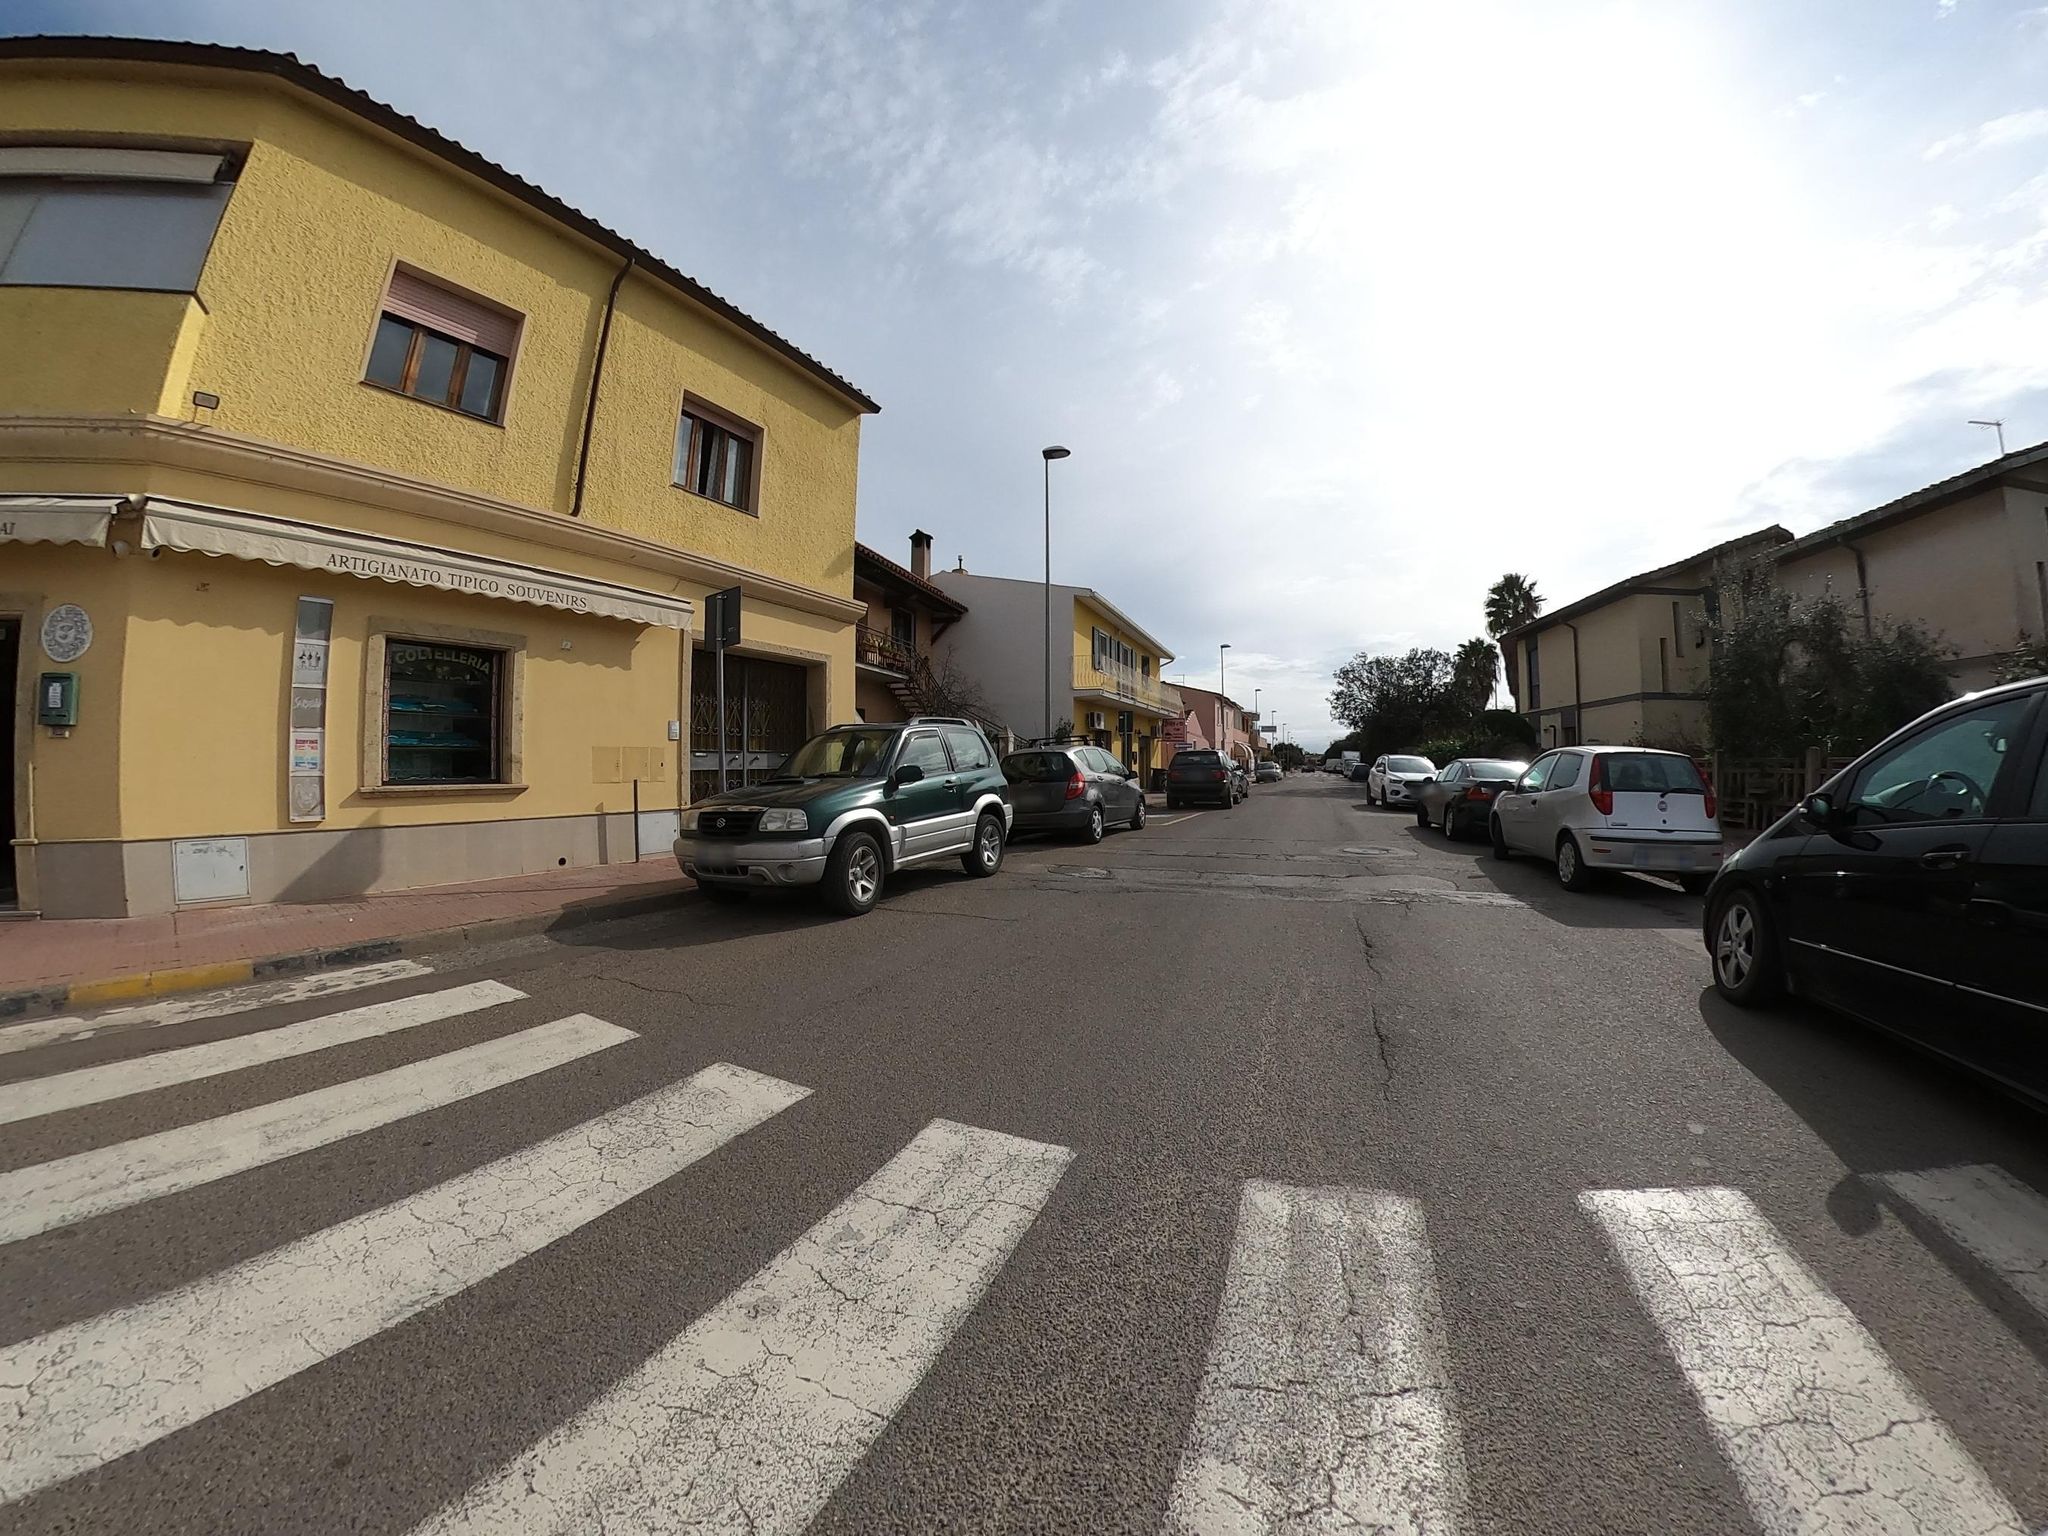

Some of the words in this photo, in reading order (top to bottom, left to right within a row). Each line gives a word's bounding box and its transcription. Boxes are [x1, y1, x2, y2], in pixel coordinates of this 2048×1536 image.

[326, 553, 441, 583] ARTIGIANATO
[448, 572, 499, 593] TIPICO
[506, 583, 588, 609] SOUVENIRS
[395, 648, 491, 675] COLTELLERIA
